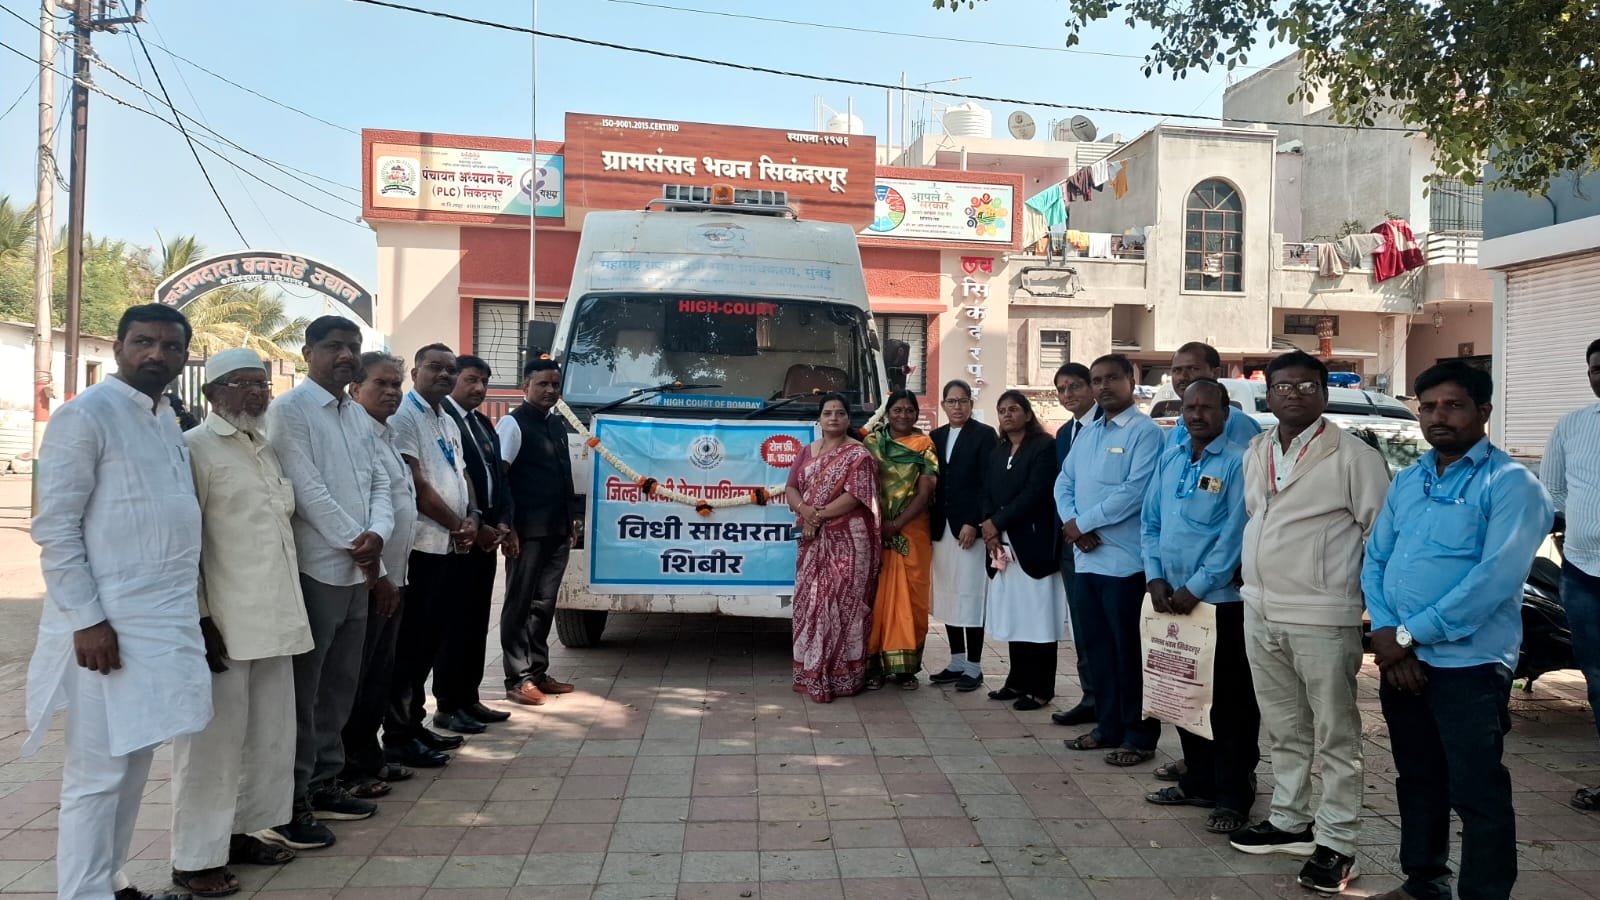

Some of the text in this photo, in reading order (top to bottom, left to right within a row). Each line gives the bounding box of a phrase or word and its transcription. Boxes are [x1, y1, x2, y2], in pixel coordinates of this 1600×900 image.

[422, 166, 456, 182] पंचायत
[602, 147, 848, 193] ग्रामसंसद भवन सिकंदरपूर
[432, 185, 461, 199] (PLC)
[678, 300, 777, 316] HIGH-COURT
[663, 398, 684, 407] HIGH
[686, 399, 713, 408] COURT
[715, 400, 725, 408] OF
[726, 401, 761, 409] BOMBAY
[618, 515, 682, 540] विधी
[661, 549, 743, 574] शिबीर
